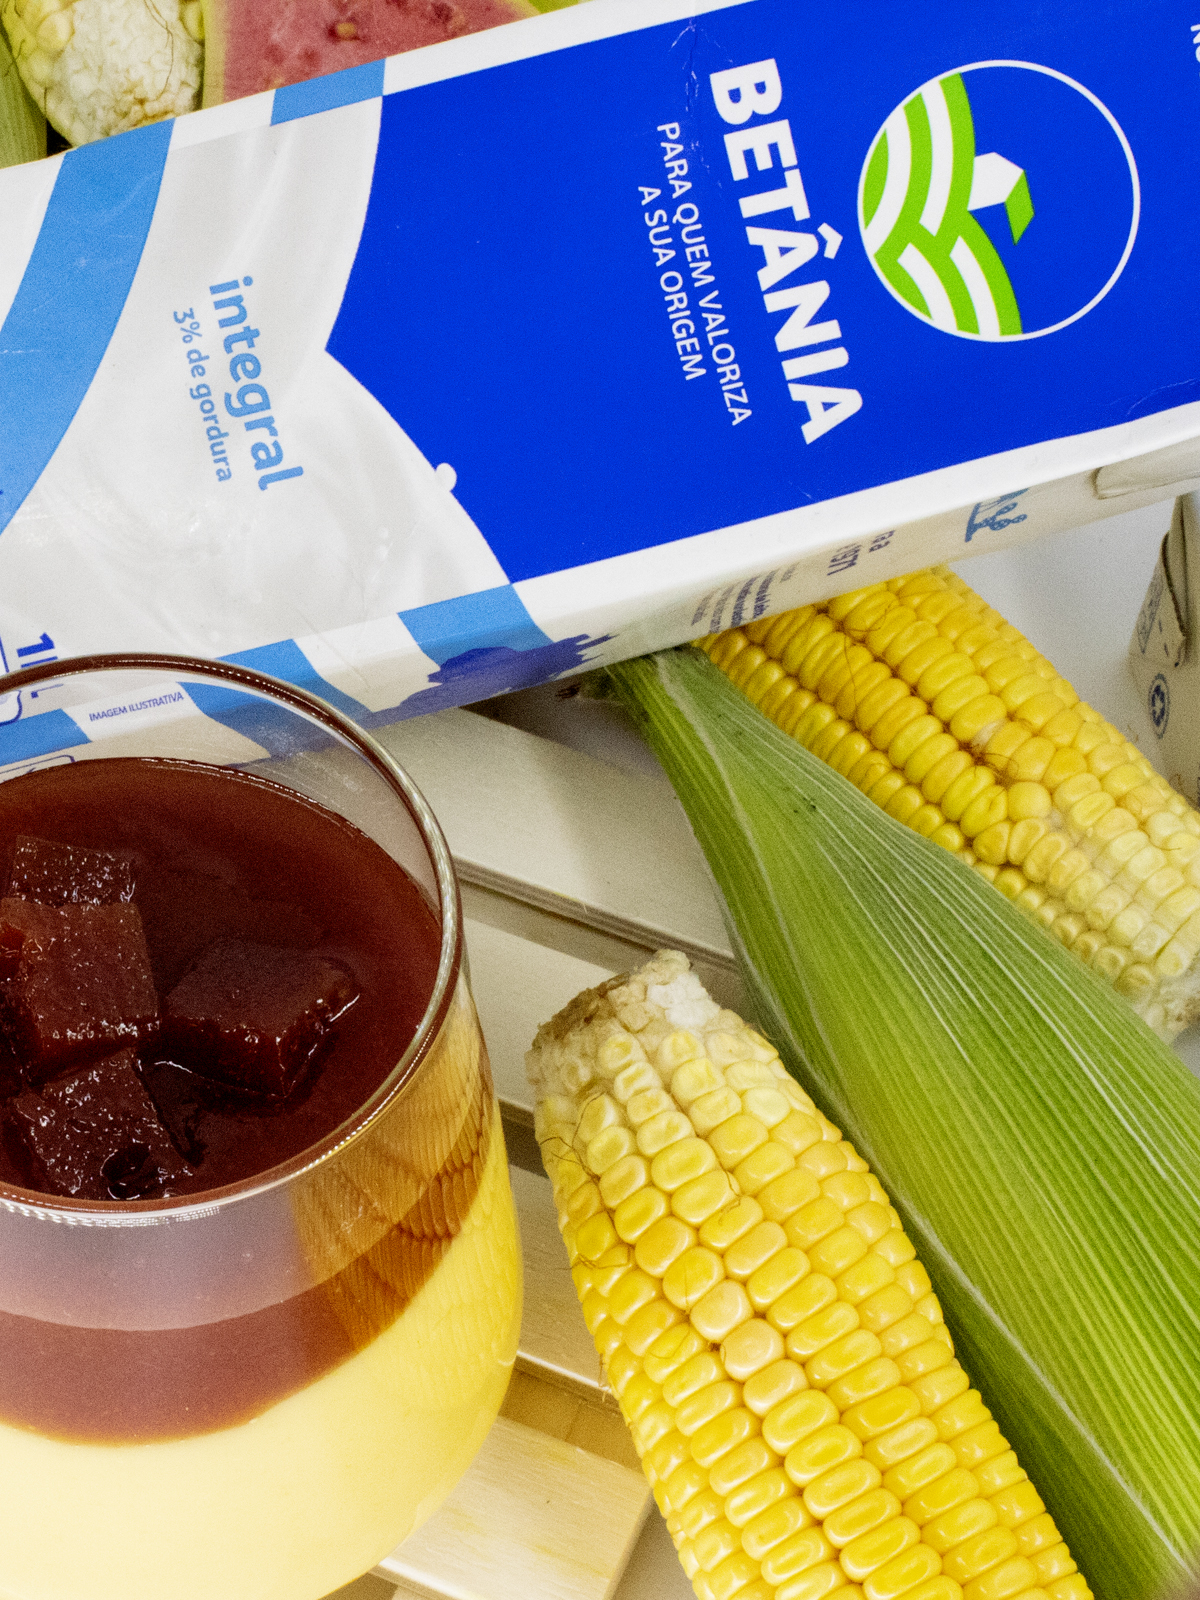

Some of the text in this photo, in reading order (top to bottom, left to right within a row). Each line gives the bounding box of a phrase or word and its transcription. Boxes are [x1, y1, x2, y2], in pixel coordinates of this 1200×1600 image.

[638, 186, 707, 381] A SUA ORIGEM
[657, 122, 753, 426] PARA QUEM VALORIZA
[709, 58, 864, 445] BETÂNIA
[173, 307, 233, 482] 3% de gordura
[209, 275, 304, 492] integral
[89, 691, 185, 722] IMAGEM ILUSTRATIVA
